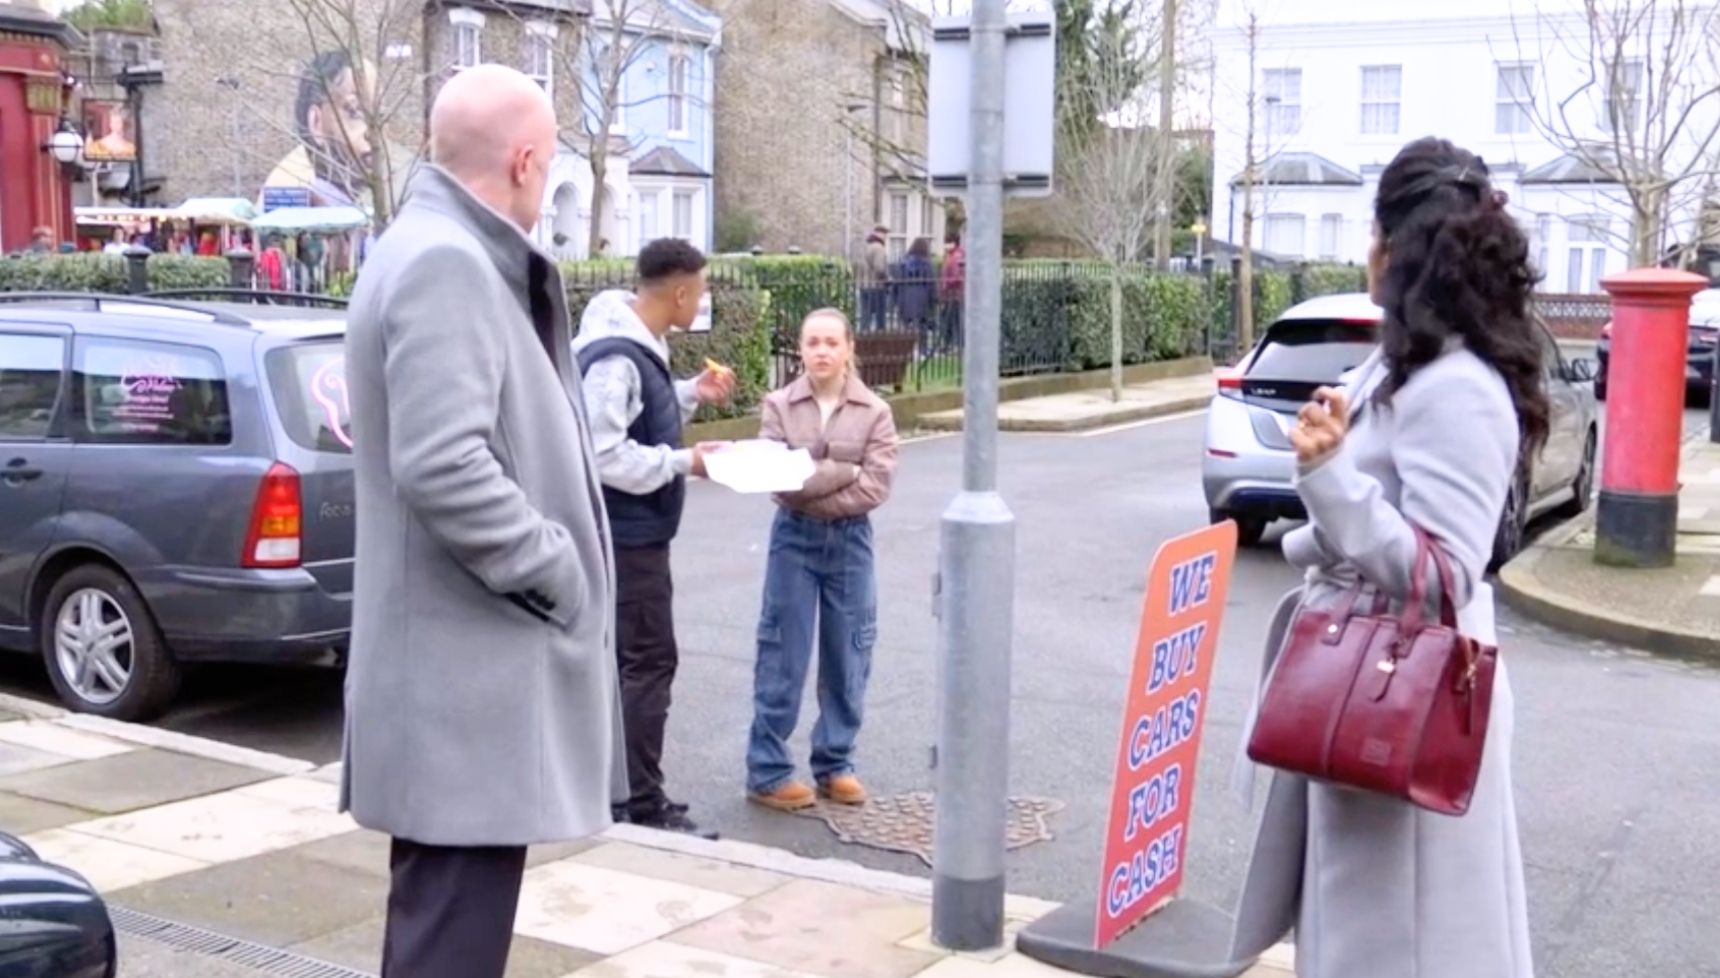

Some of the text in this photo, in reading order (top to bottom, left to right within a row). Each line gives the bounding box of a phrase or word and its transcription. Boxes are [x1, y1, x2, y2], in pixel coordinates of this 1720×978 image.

[1169, 551, 1216, 615] WE
[1147, 622, 1207, 693] BUY
[1129, 689, 1200, 770] CARS
[1125, 764, 1180, 841] FOR
[1108, 824, 1182, 917] CASH
